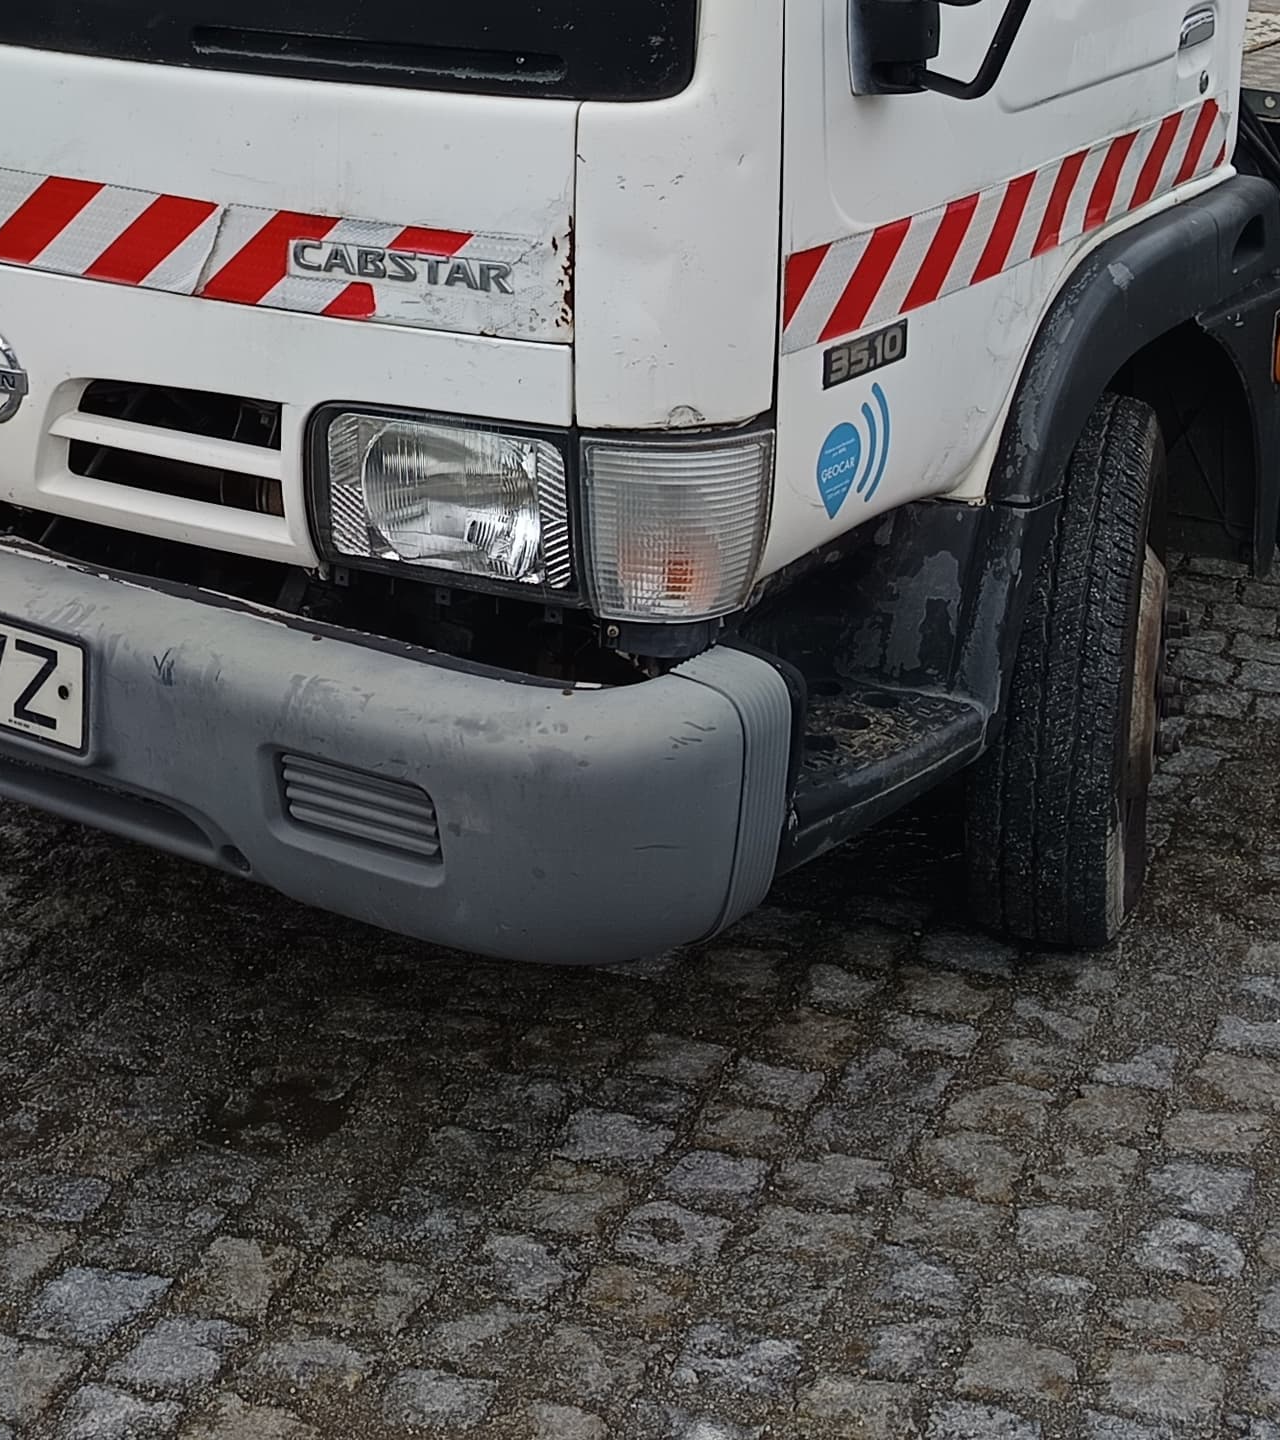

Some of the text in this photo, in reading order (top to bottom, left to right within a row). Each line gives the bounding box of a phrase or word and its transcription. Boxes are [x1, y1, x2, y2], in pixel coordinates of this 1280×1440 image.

[293, 242, 515, 295] CABSTAR
[829, 327, 903, 383] 35.10
[821, 456, 856, 483] GEOCAR
